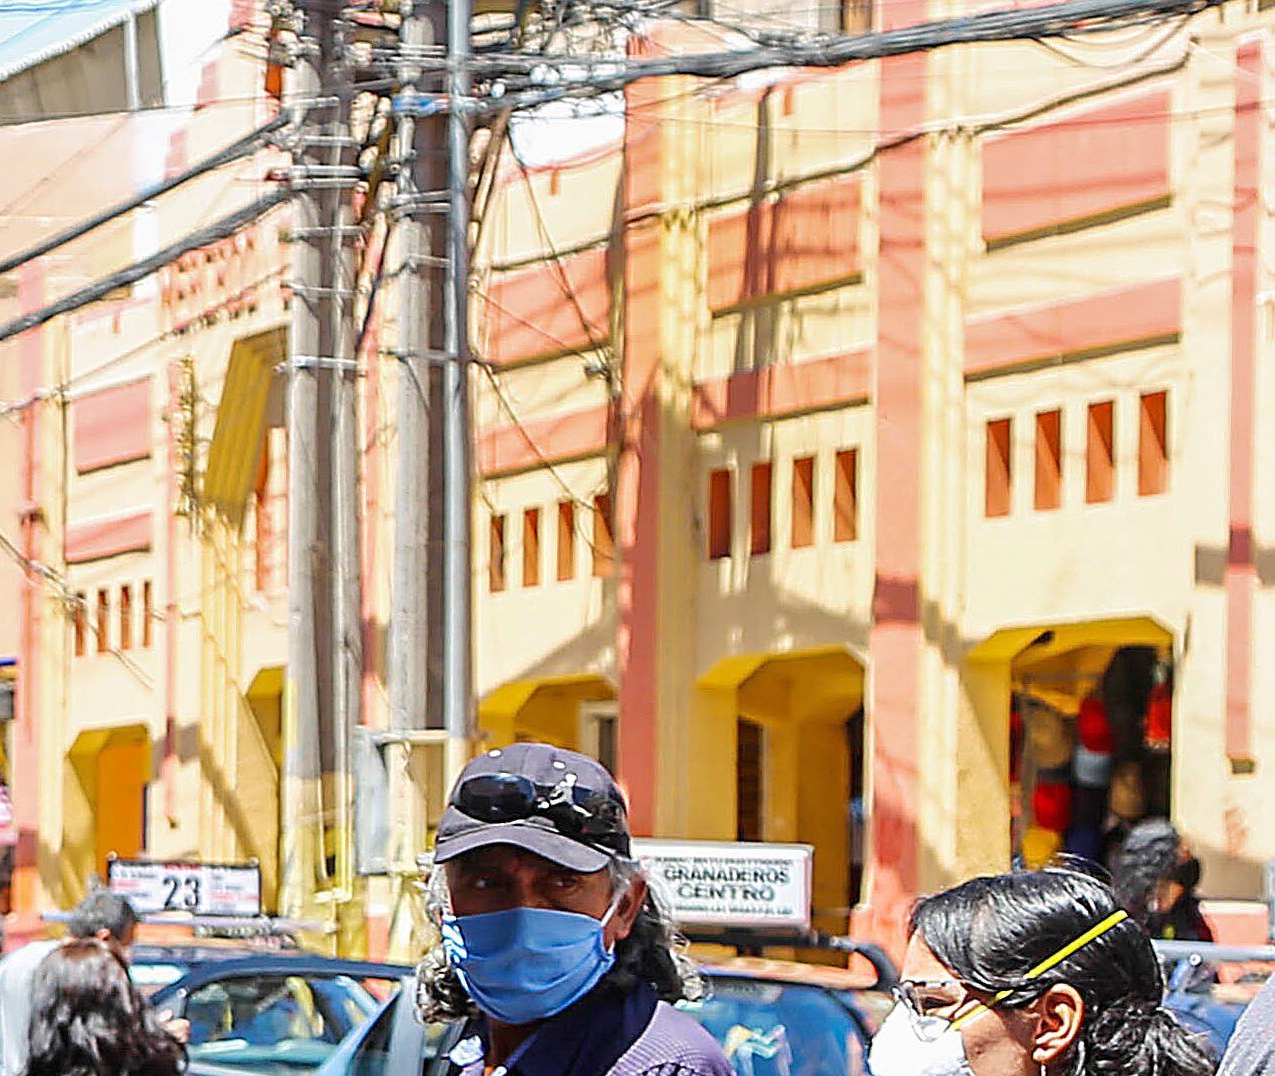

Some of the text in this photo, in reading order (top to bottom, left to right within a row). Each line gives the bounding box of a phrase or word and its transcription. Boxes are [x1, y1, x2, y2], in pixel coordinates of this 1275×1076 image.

[663, 866, 791, 884] GRANADEROS
[162, 876, 200, 909] 23
[677, 883, 776, 901] CENTRO
